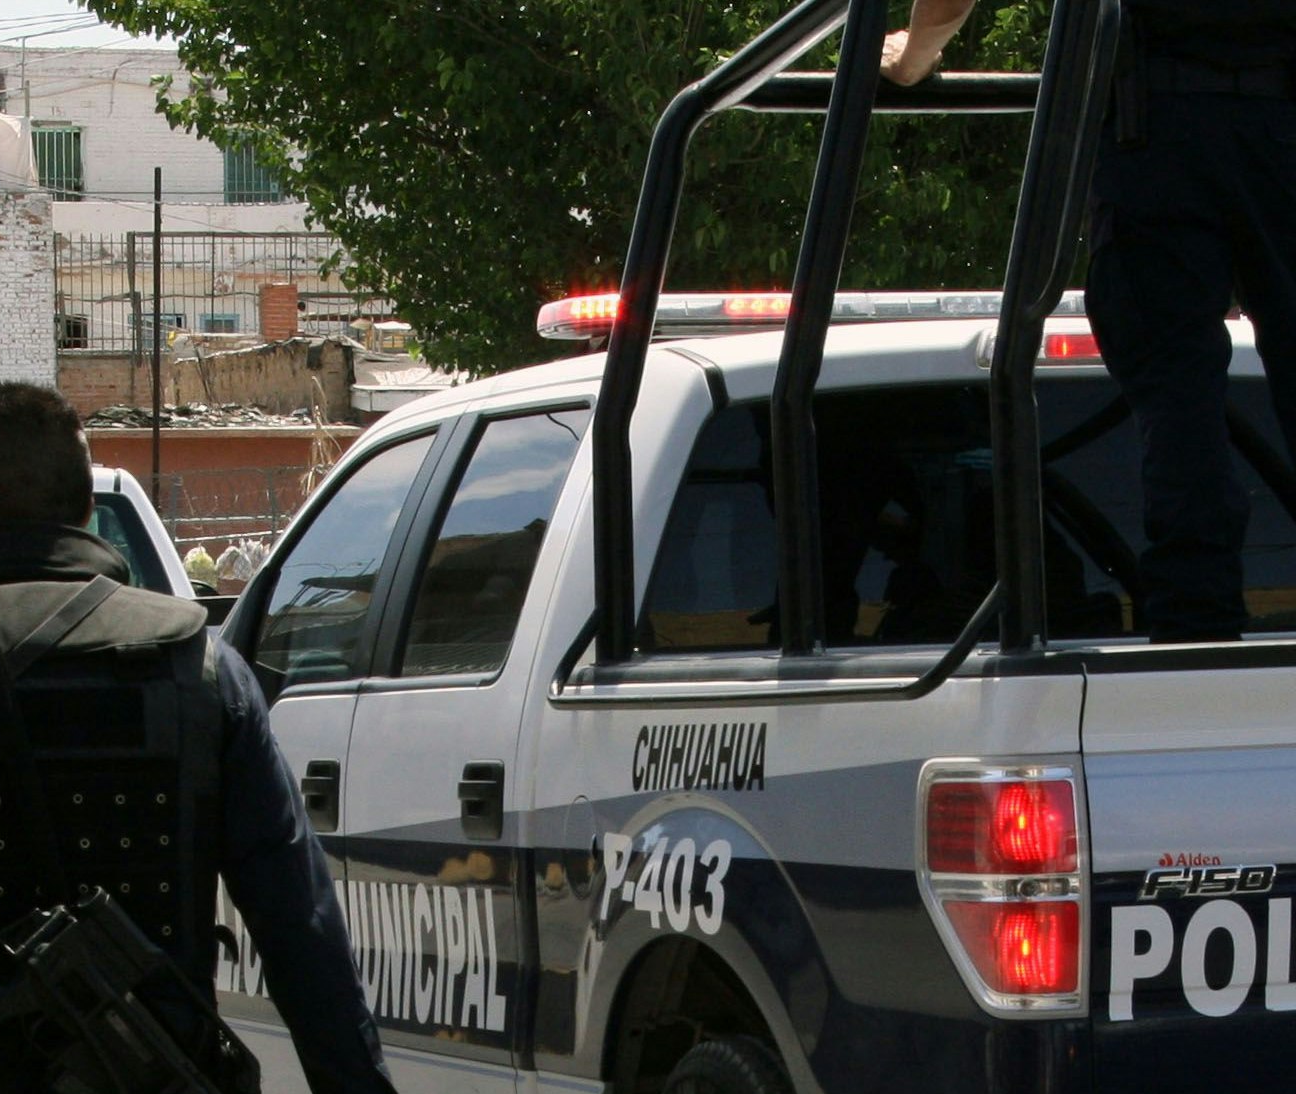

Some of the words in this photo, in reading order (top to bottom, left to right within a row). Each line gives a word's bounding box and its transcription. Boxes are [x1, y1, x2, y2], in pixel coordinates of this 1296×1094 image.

[632, 722, 766, 793] CHIHUAHUA
[599, 831, 732, 937] P-403
[1175, 853, 1222, 867] Alden
